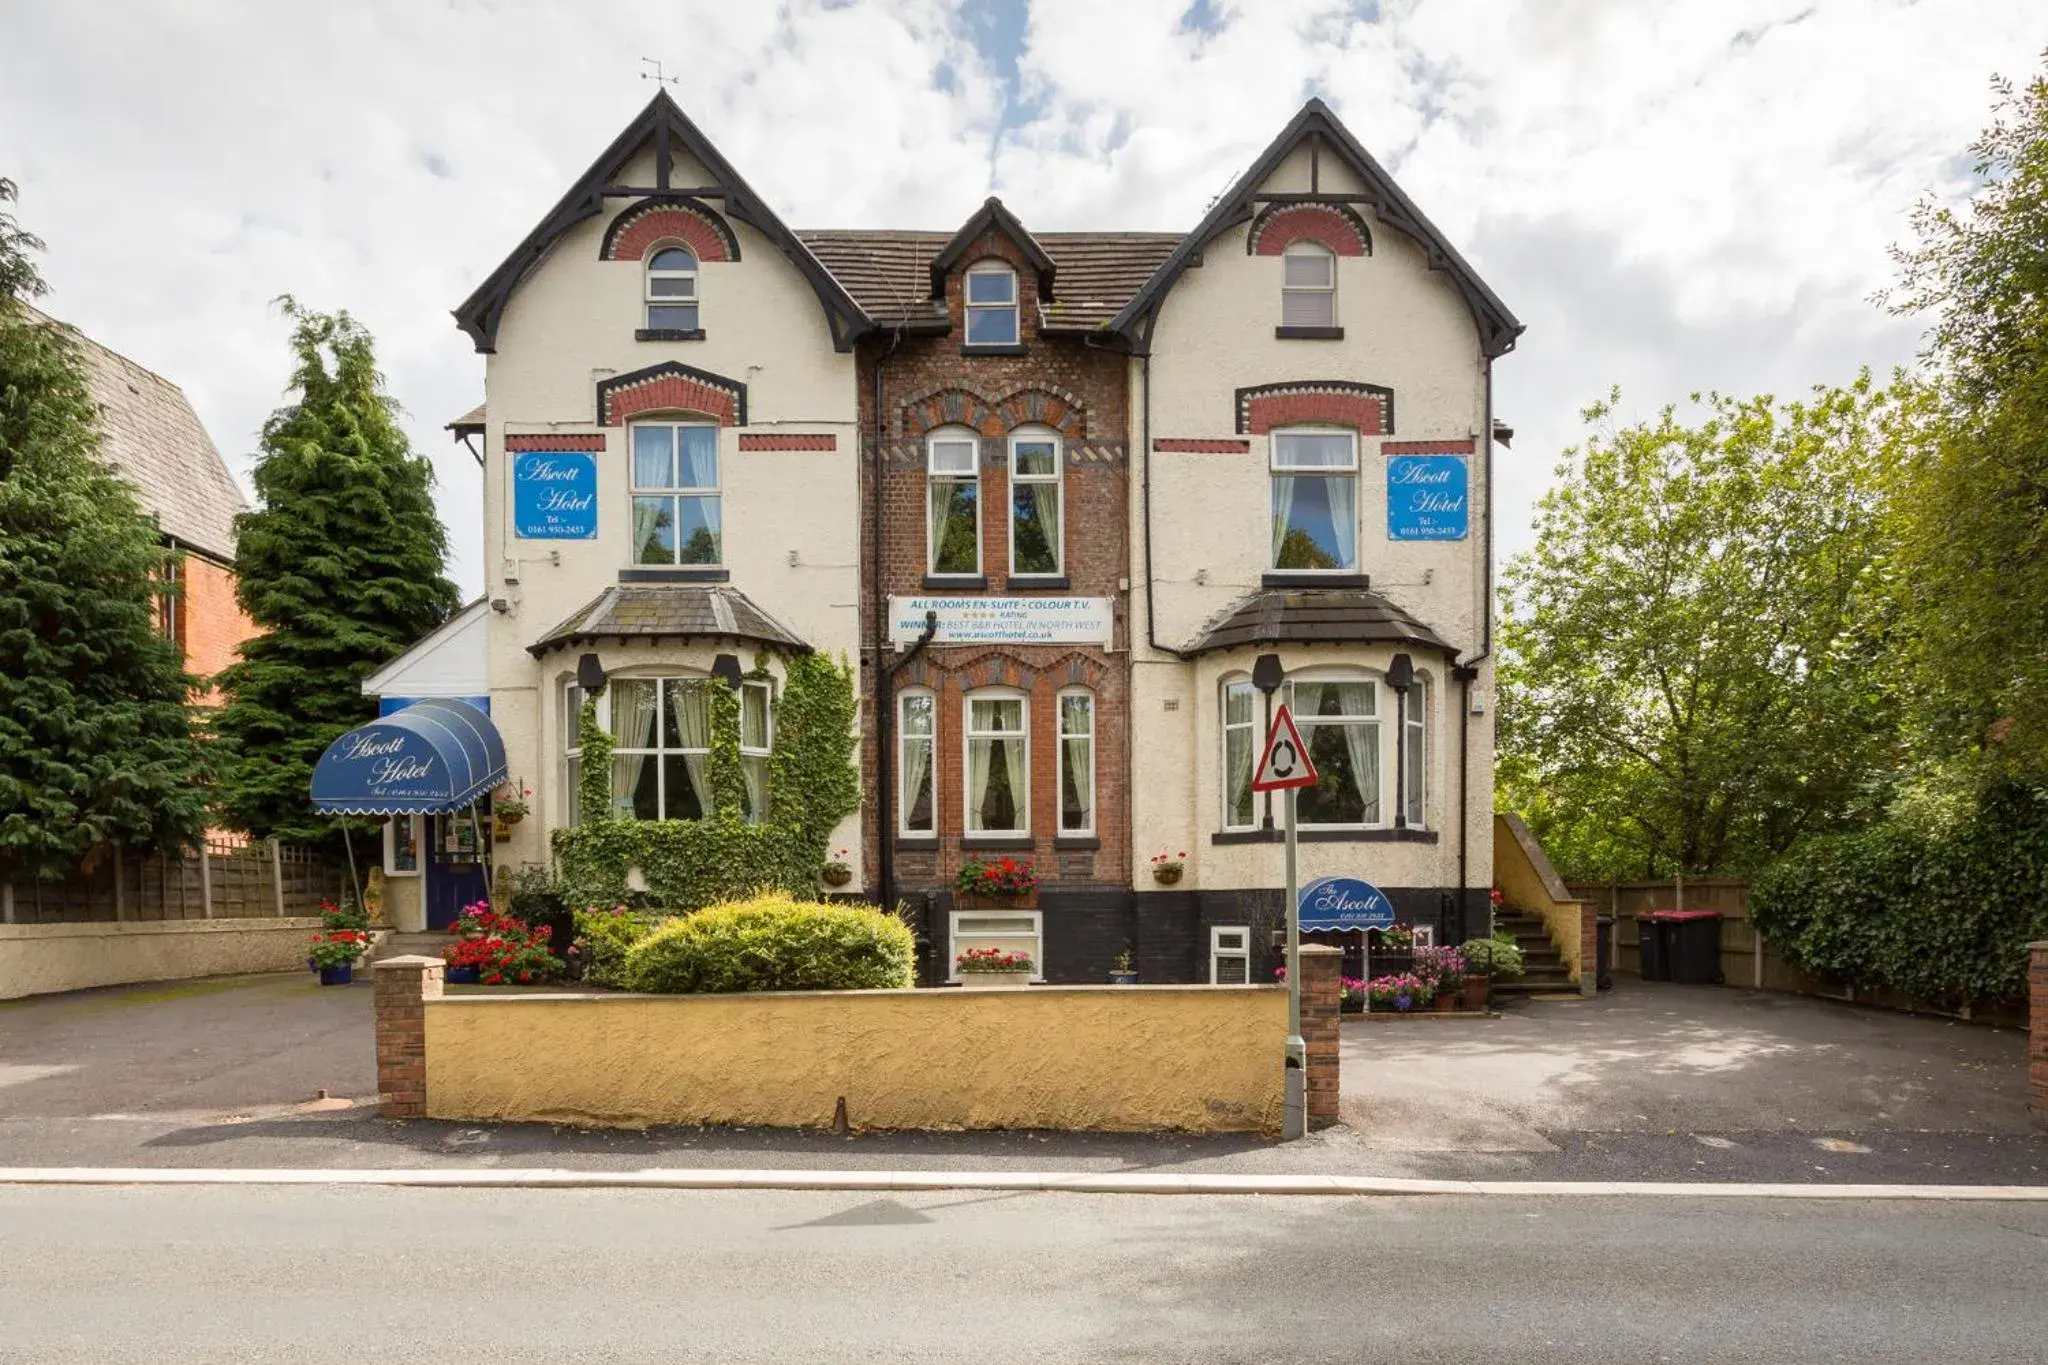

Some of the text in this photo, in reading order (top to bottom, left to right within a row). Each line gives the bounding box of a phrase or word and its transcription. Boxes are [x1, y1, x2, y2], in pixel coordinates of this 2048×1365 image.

[518, 457, 580, 481] Ascott
[1390, 461, 1451, 485] Ascott
[536, 486, 592, 511] Hotel
[1409, 489, 1464, 513] Hotel
[910, 600, 929, 609] ALL
[931, 600, 970, 609] ROOMS
[973, 600, 1020, 610] EN-SUITE
[1027, 601, 1070, 610] COLOUR
[1000, 611, 1028, 619] RATING
[947, 620, 970, 630] BEST
[971, 620, 991, 630] B&B
[993, 620, 1024, 630] HOTEL
[1026, 621, 1037, 630] IN
[1037, 621, 1073, 630] NORTH
[1074, 621, 1102, 630] WEST
[948, 631, 1052, 639] www.ascotthotel.co.uk
[331, 731, 405, 763] Ascott
[367, 755, 434, 786] Hotel
[1315, 889, 1379, 911] Ascott
[1318, 884, 1338, 896] The
